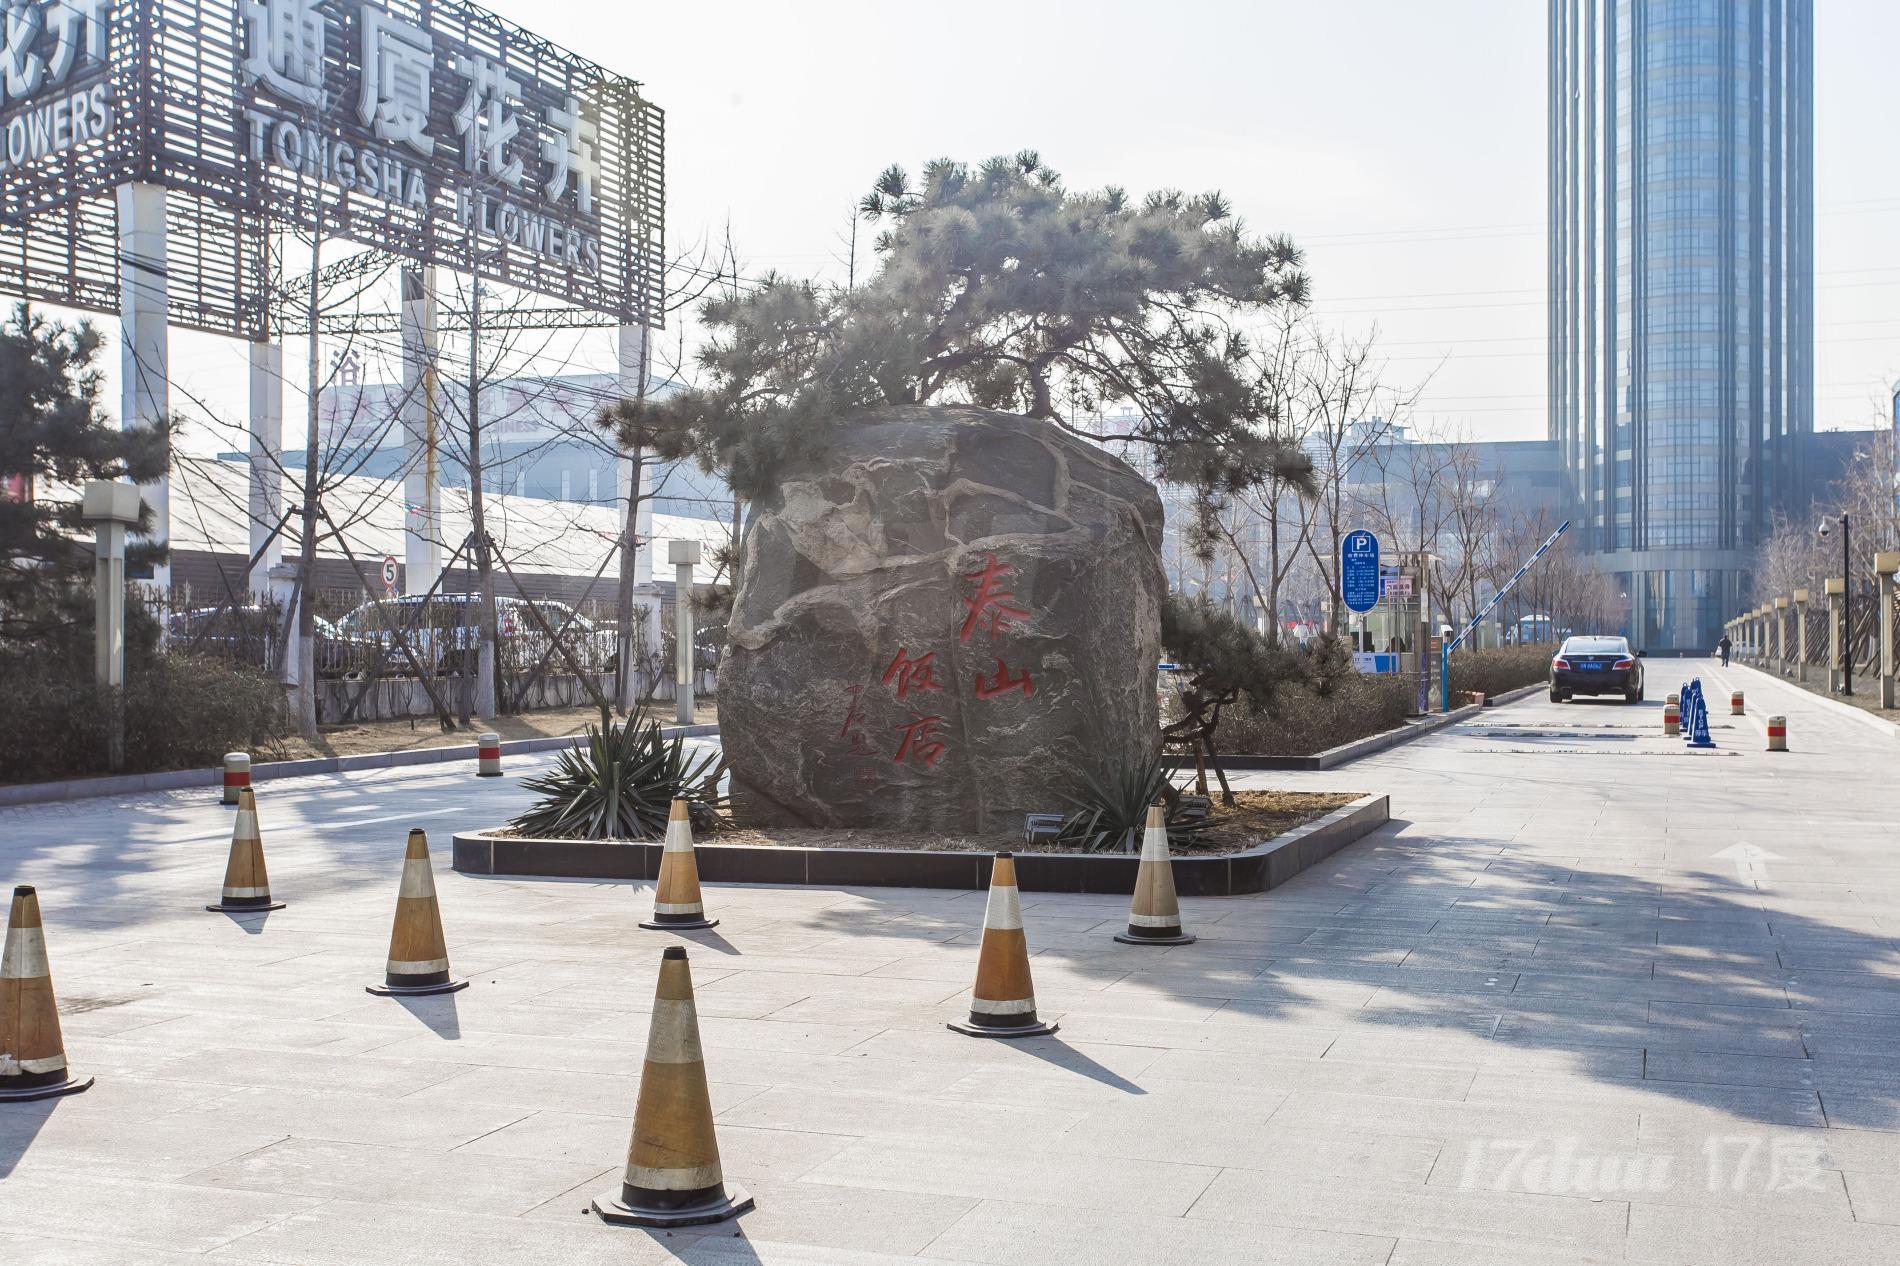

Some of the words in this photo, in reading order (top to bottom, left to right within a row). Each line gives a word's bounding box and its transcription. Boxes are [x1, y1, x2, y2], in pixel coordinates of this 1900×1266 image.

[0, 82, 114, 171] OWERS
[243, 108, 427, 215] TONGSHA
[456, 186, 601, 273] FLOWERS
[1356, 538, 1368, 550] P
[385, 563, 395, 582] 5
